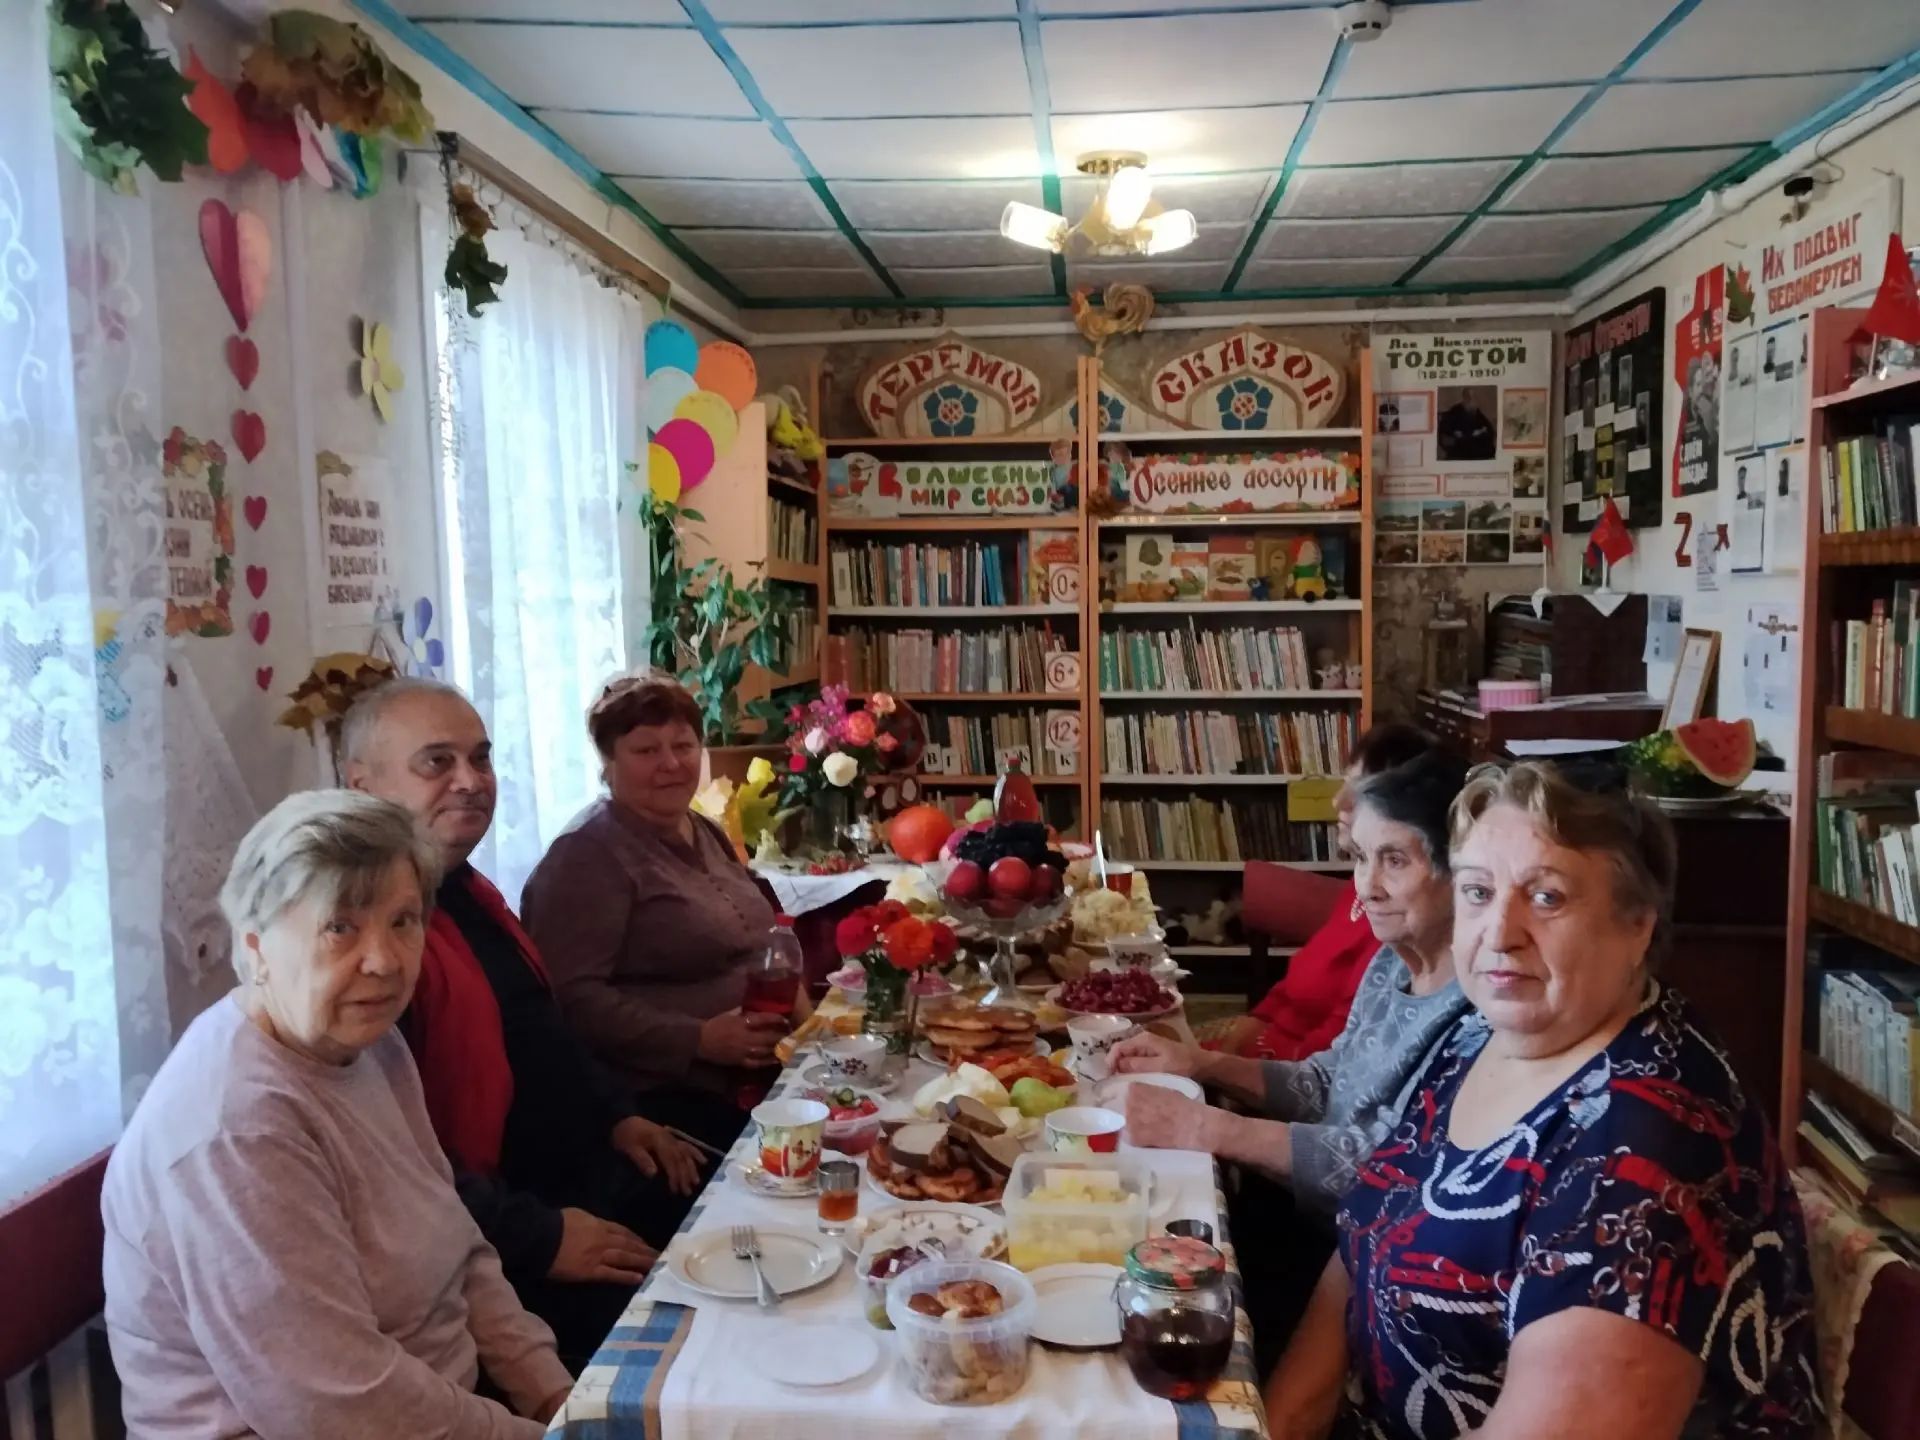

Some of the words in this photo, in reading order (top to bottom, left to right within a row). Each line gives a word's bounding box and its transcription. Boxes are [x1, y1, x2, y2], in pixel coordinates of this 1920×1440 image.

[1386, 346, 1527, 369] ТОЛСТОЙ
[868, 343, 1040, 421] ТЕРЕМОК
[1156, 337, 1334, 412] СКАЗОК
[878, 462, 1052, 502] ВОЛШЕБНЫ
[1133, 461, 1231, 505] Осеннее
[1243, 466, 1338, 499] ассорти
[911, 487, 961, 510] МИР
[971, 486, 1051, 507] СКАЗО
[1056, 574, 1080, 596] 0+
[1053, 658, 1077, 683] 6+
[1052, 720, 1080, 743] 12+
